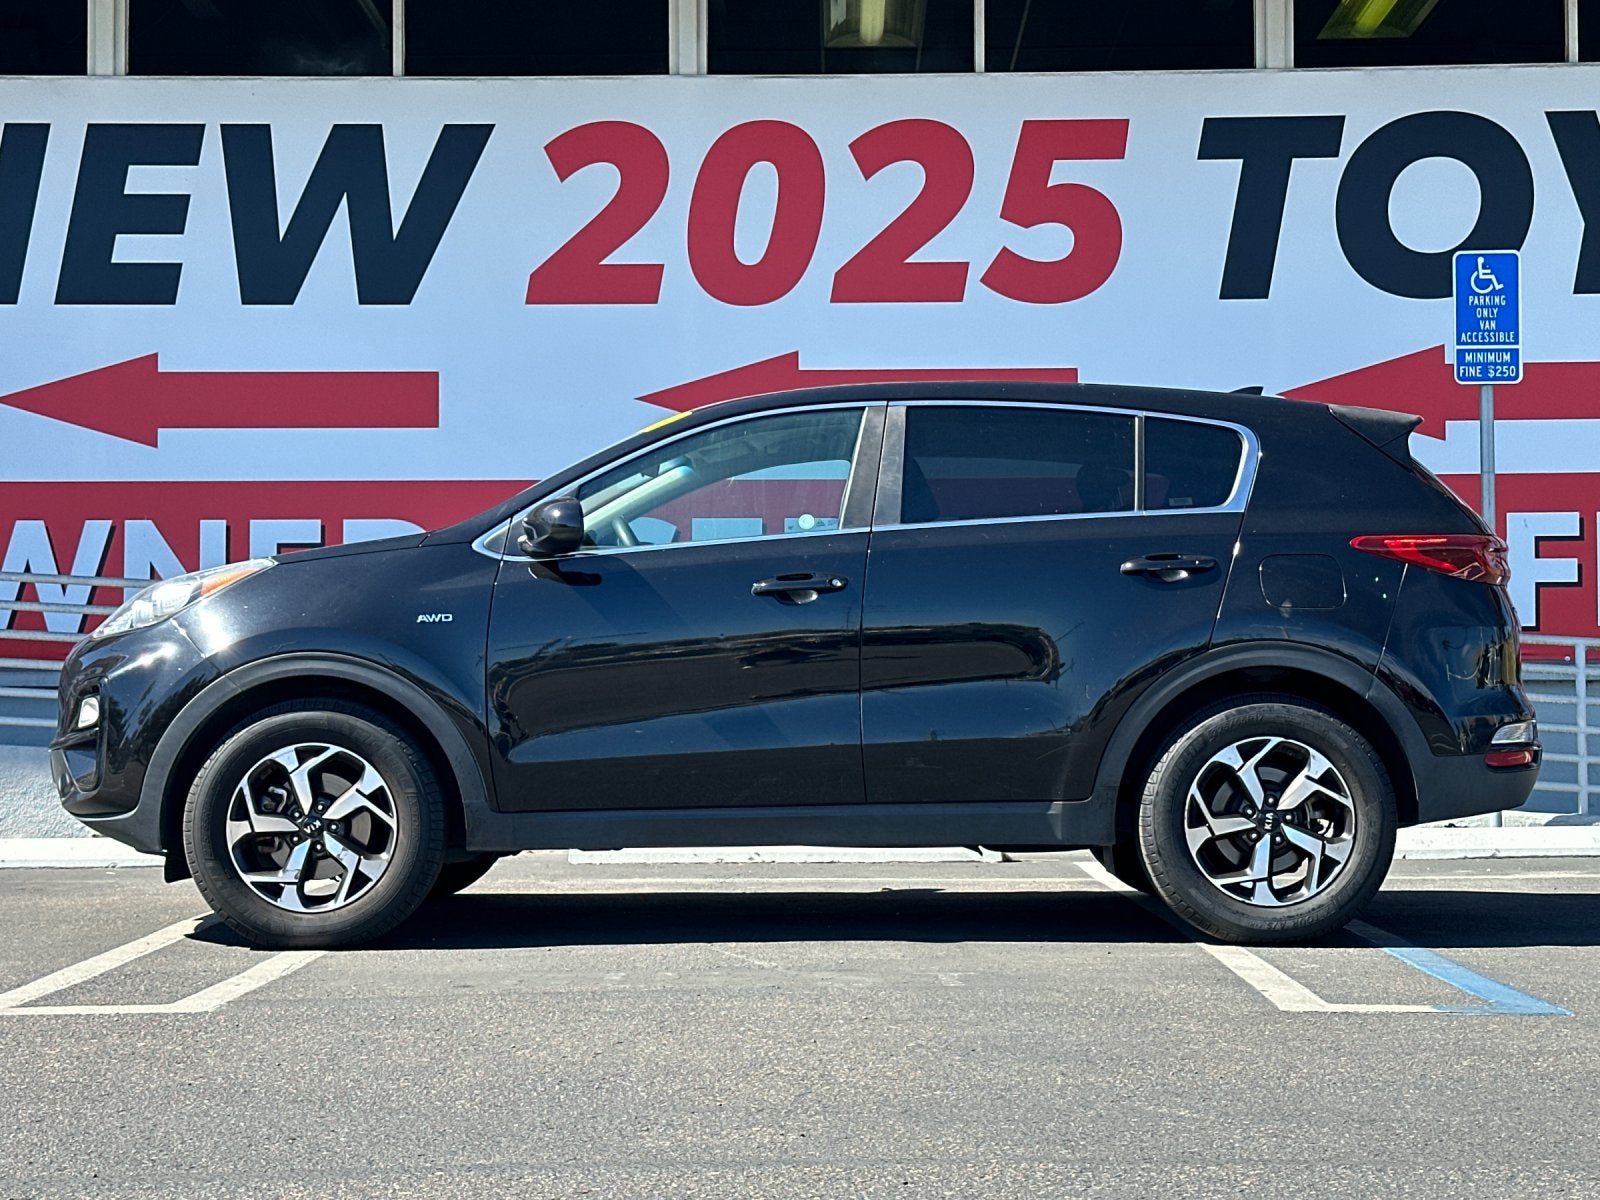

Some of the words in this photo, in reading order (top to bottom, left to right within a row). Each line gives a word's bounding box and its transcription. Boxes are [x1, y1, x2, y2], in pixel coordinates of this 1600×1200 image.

[525, 119, 1129, 305] 2025
[1468, 295, 1506, 306] PARKING
[1476, 308, 1499, 318] ONLY
[1480, 320, 1496, 331] VAN
[1460, 332, 1515, 343] ACCESSIBLE
[1465, 352, 1511, 363] MINIMUM
[1459, 366, 1483, 377] FINE
[1487, 366, 1517, 378] $250
[416, 613, 453, 623] AWD
[303, 819, 322, 834] KIA
[1264, 812, 1274, 830] KIA
